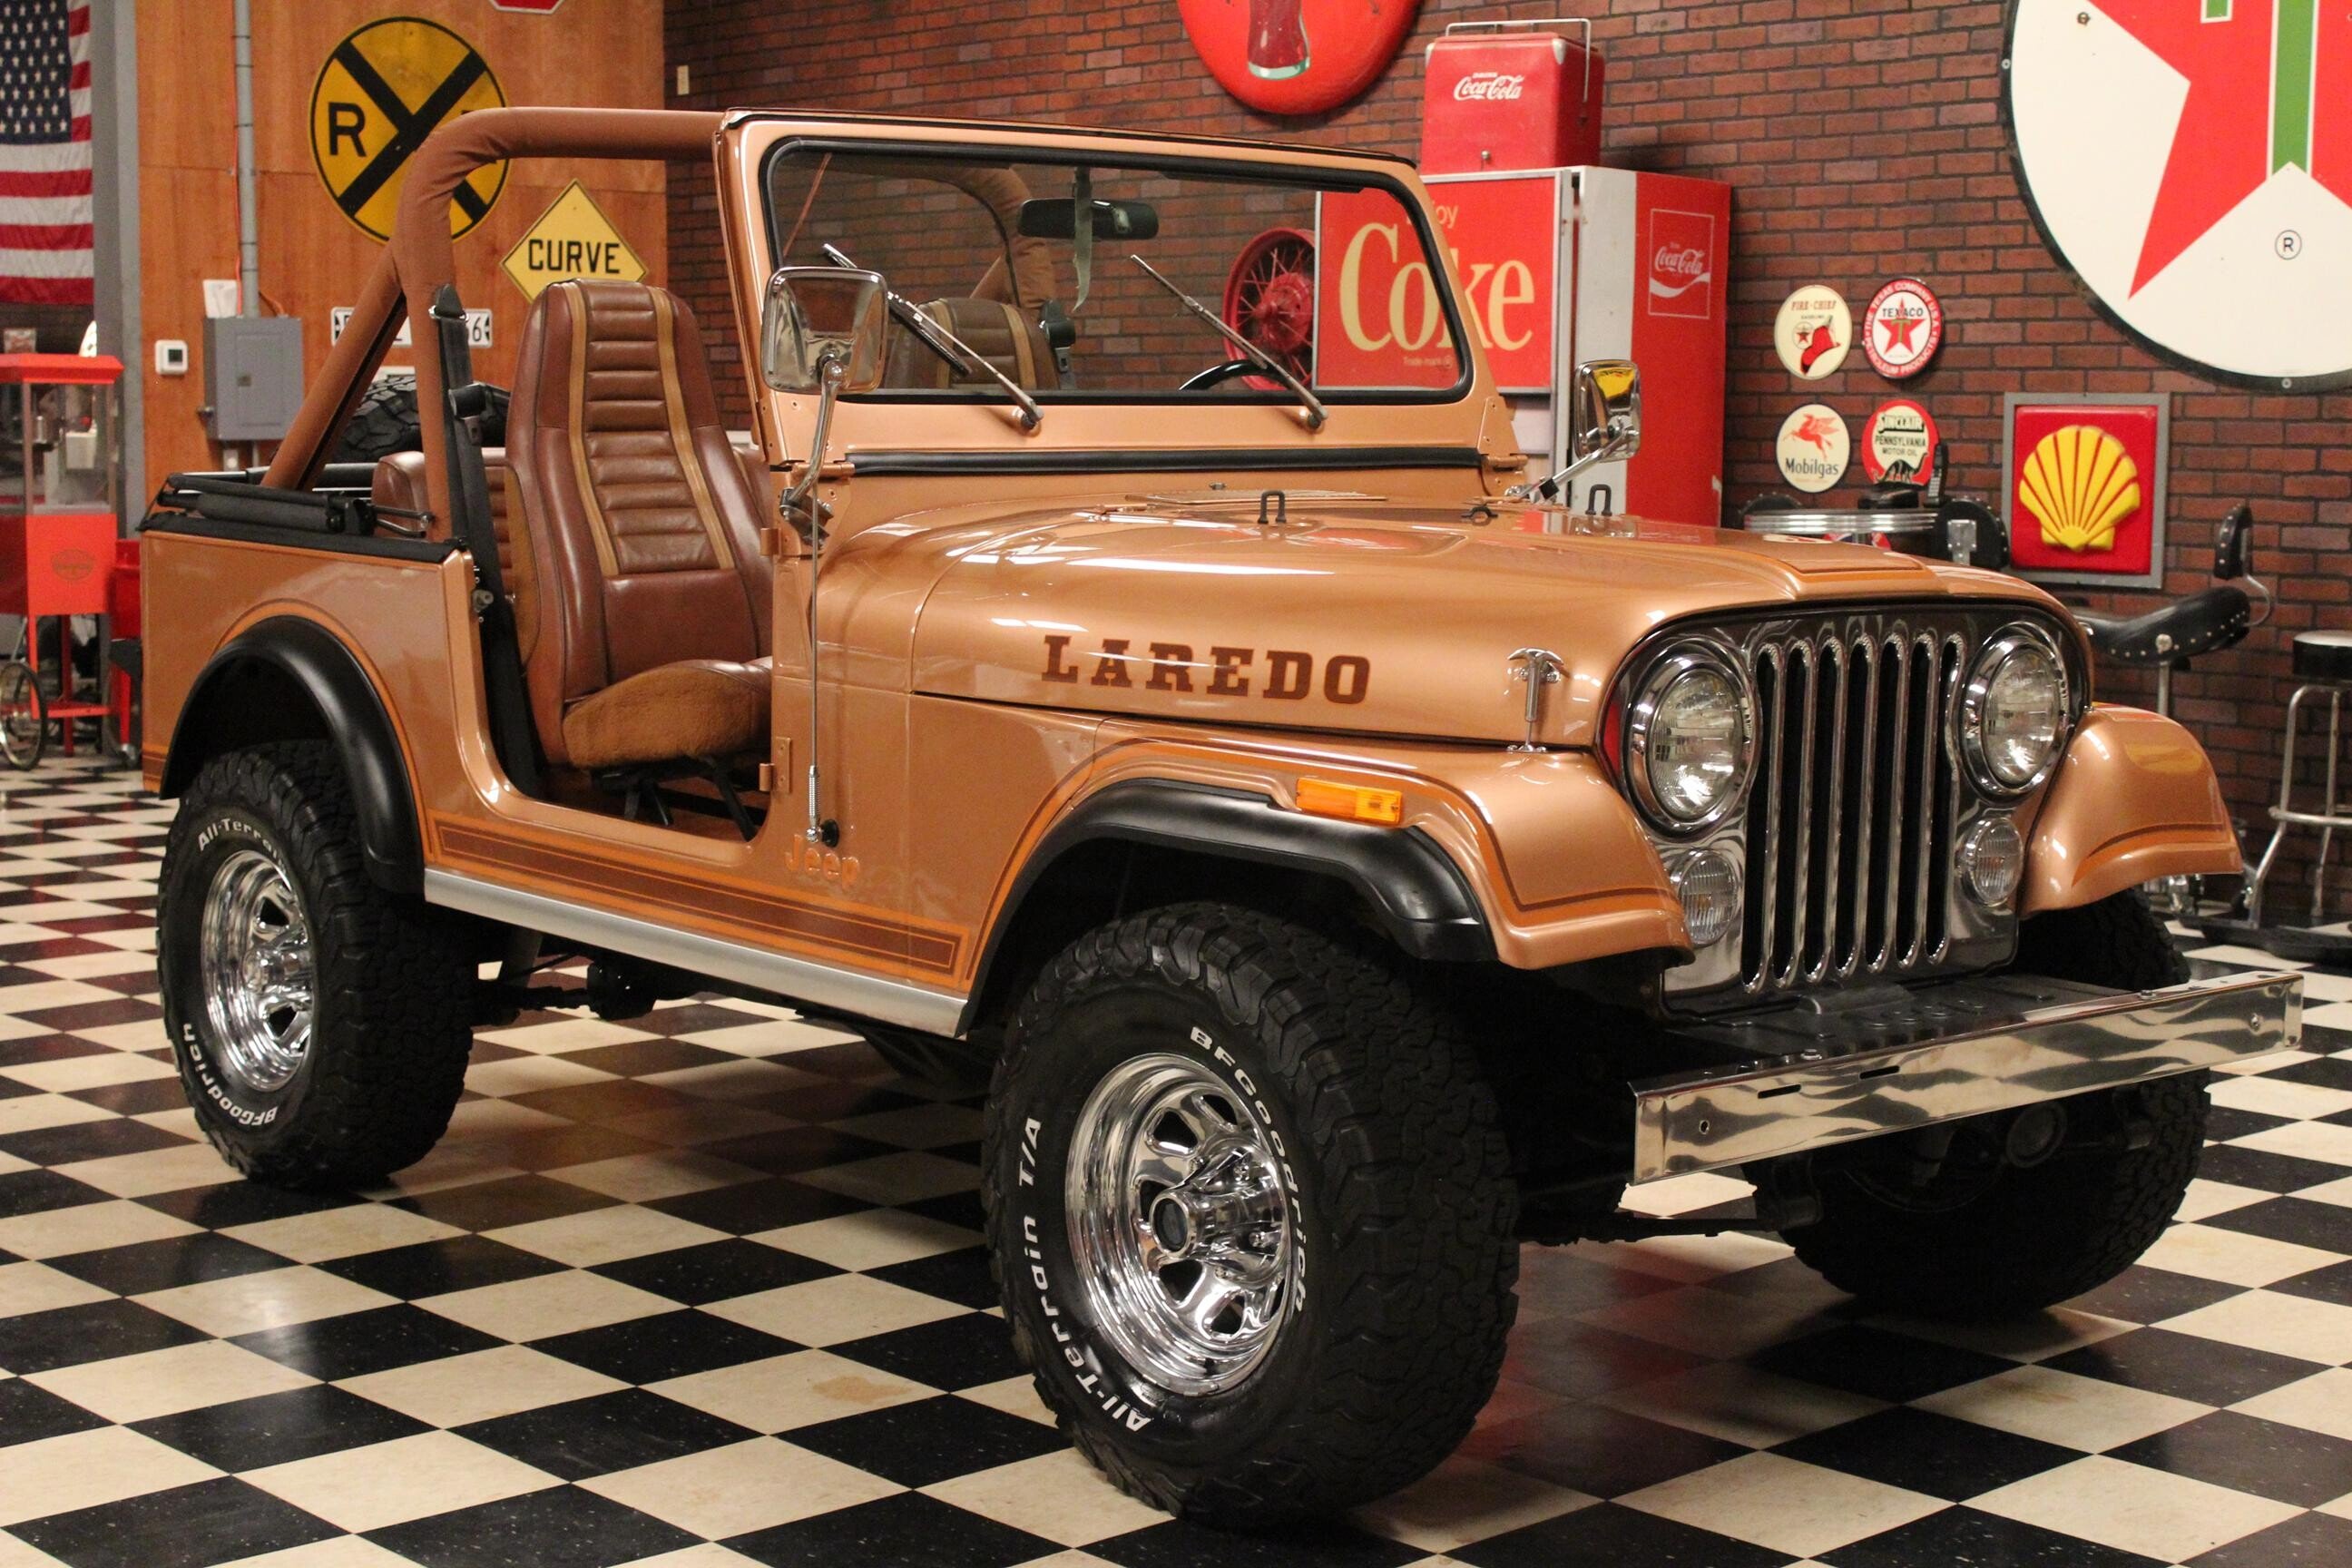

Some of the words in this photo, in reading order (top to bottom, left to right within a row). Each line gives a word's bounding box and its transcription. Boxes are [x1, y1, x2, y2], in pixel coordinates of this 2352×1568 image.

[1453, 74, 1524, 101] Coca-Cola
[328, 102, 368, 157] R
[528, 239, 621, 274] CURVE
[1654, 246, 1705, 275] Coca-Cola
[1339, 222, 1535, 351] Coke
[1882, 308, 1925, 318] TEXACO
[1785, 457, 1839, 479] Mobilgas
[1875, 435, 1926, 447] PENNSYLVANIA
[1041, 634, 1371, 705] LAREDO
[784, 833, 861, 890] Jeep
[182, 1023, 279, 1126] BFGoodrich
[1018, 1117, 1043, 1188] T/A
[1190, 1025, 1307, 1313] BFGoodrich
[1023, 1214, 1154, 1432] All-Terrain
